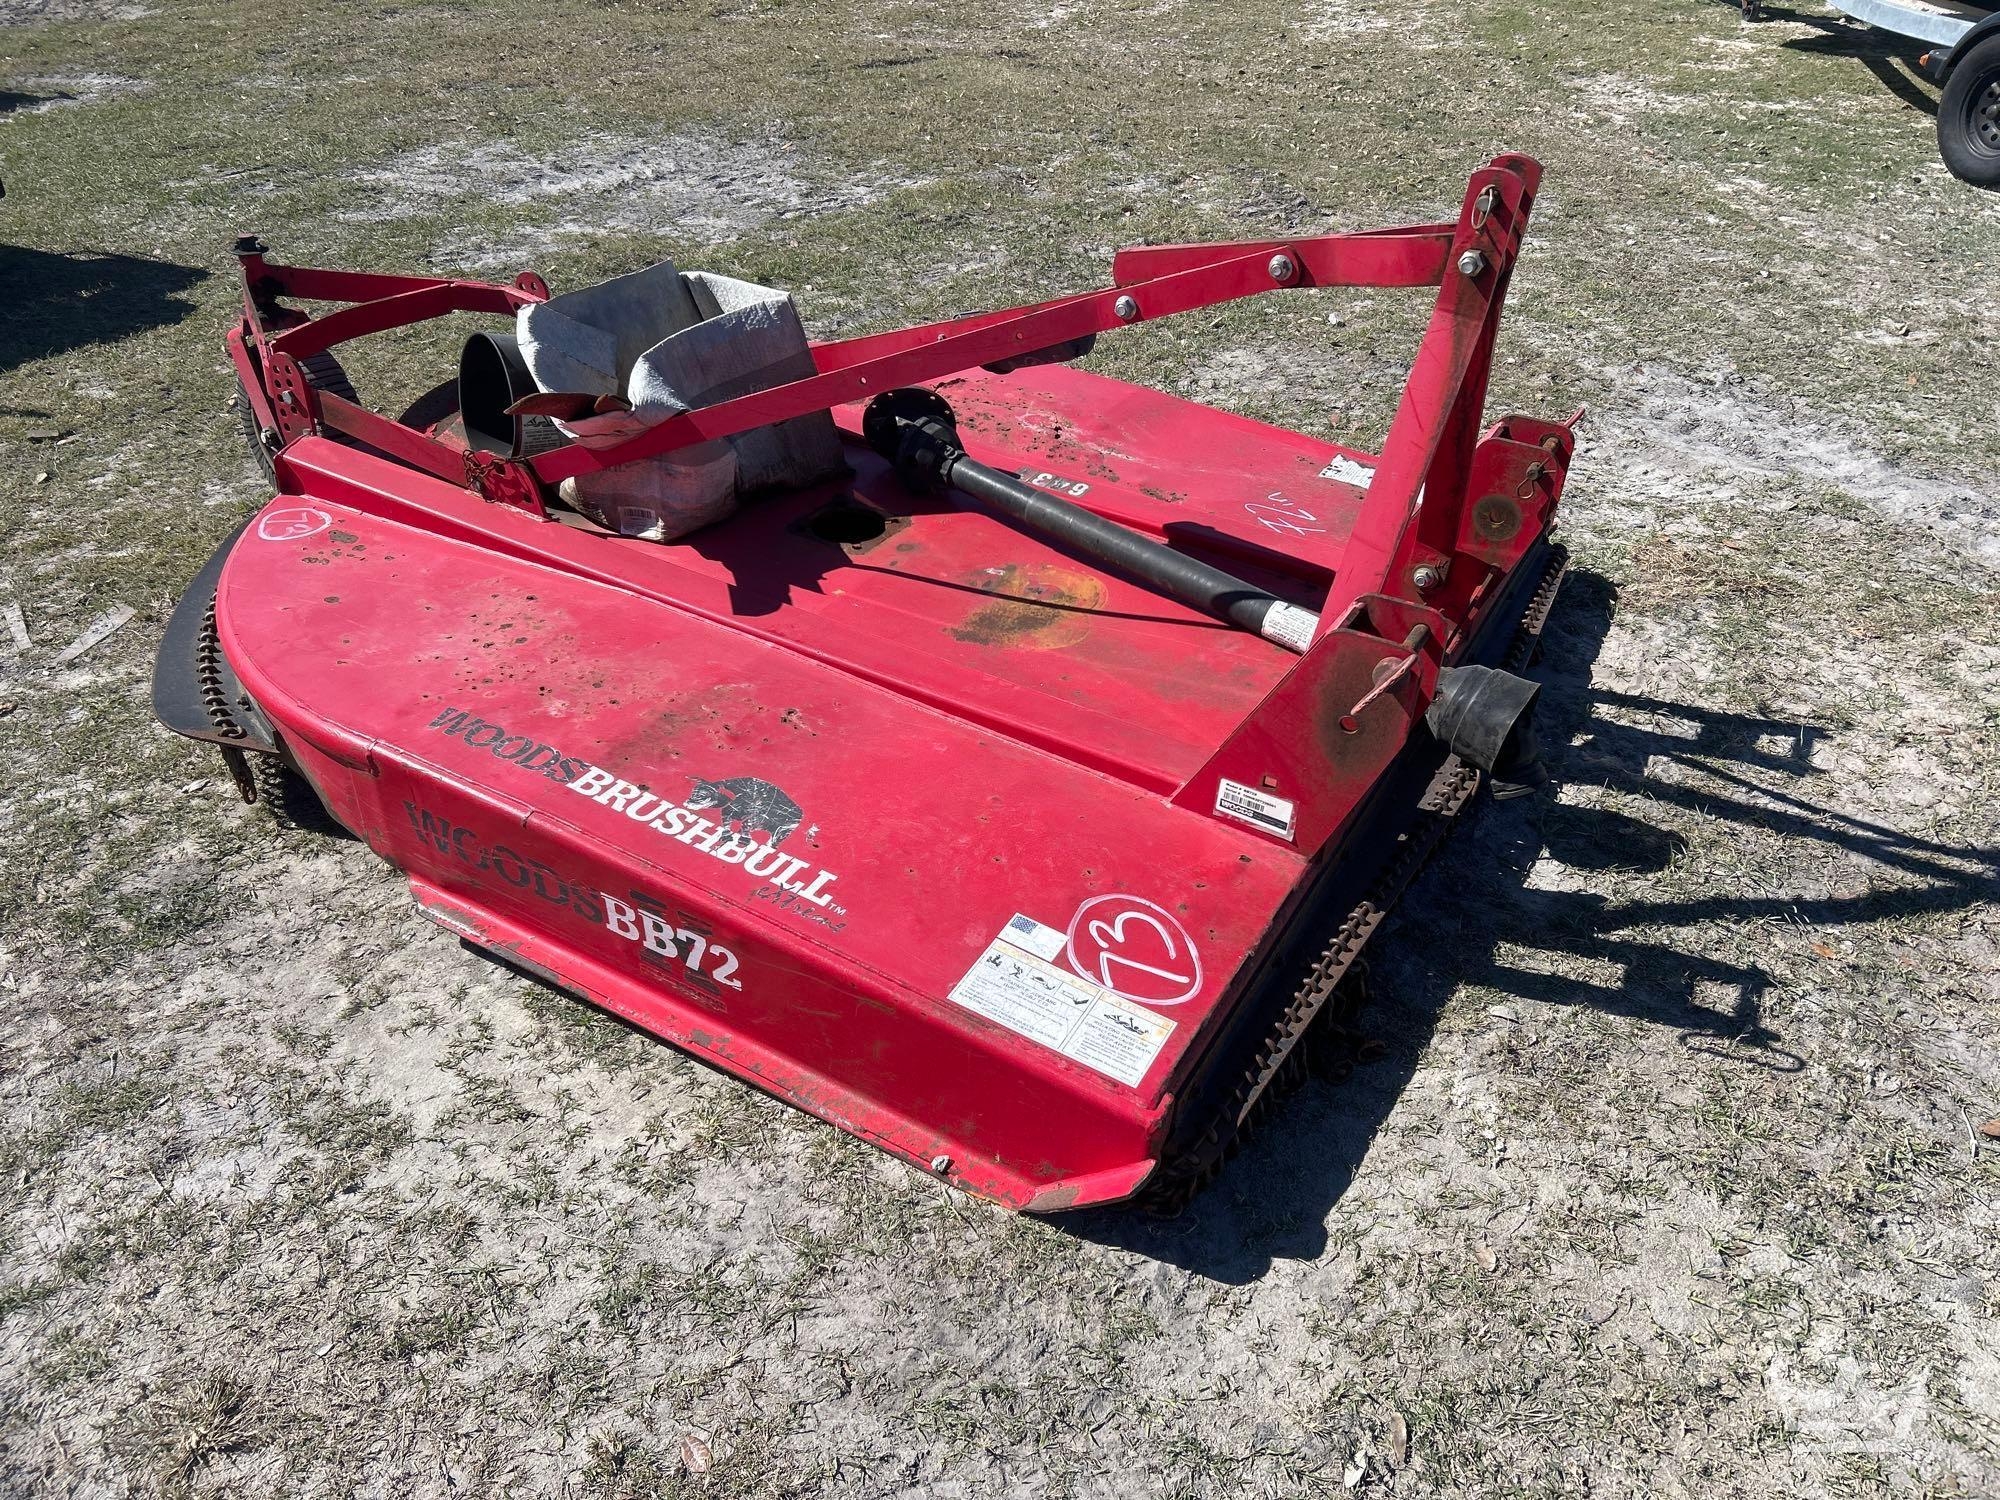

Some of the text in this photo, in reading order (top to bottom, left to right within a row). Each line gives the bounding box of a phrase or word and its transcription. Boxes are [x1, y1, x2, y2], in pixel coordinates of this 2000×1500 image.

[403, 801, 742, 991] WOODS BB72
[428, 707, 591, 782] WOODS
[566, 765, 838, 907] BRUSHBULL
[1088, 911, 1190, 988] 73
